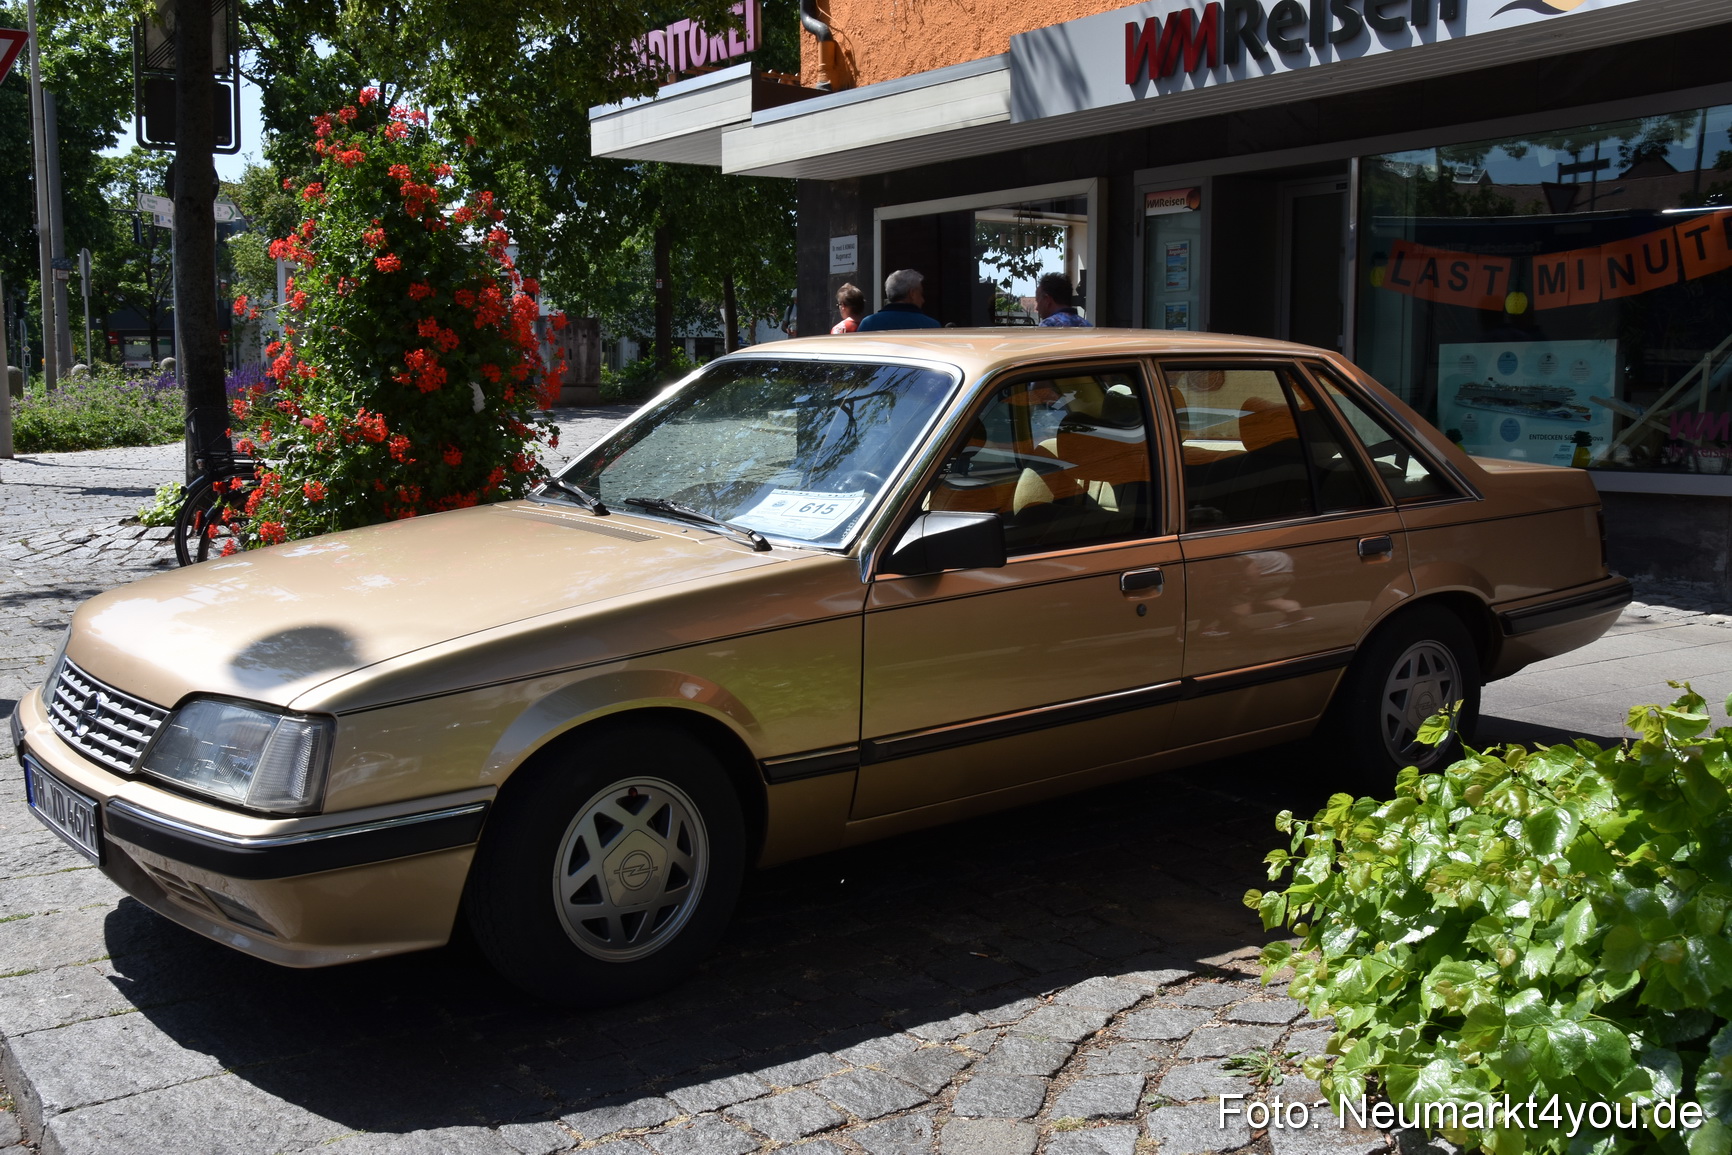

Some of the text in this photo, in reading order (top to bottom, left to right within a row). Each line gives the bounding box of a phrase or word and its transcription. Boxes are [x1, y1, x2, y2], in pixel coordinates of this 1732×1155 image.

[1146, 197, 1185, 208] WMReisen
[1390, 251, 1504, 296] LAST
[1529, 433, 1563, 441] ENTDECKEN
[798, 502, 839, 515] 615
[67, 795, 98, 849] 467H
